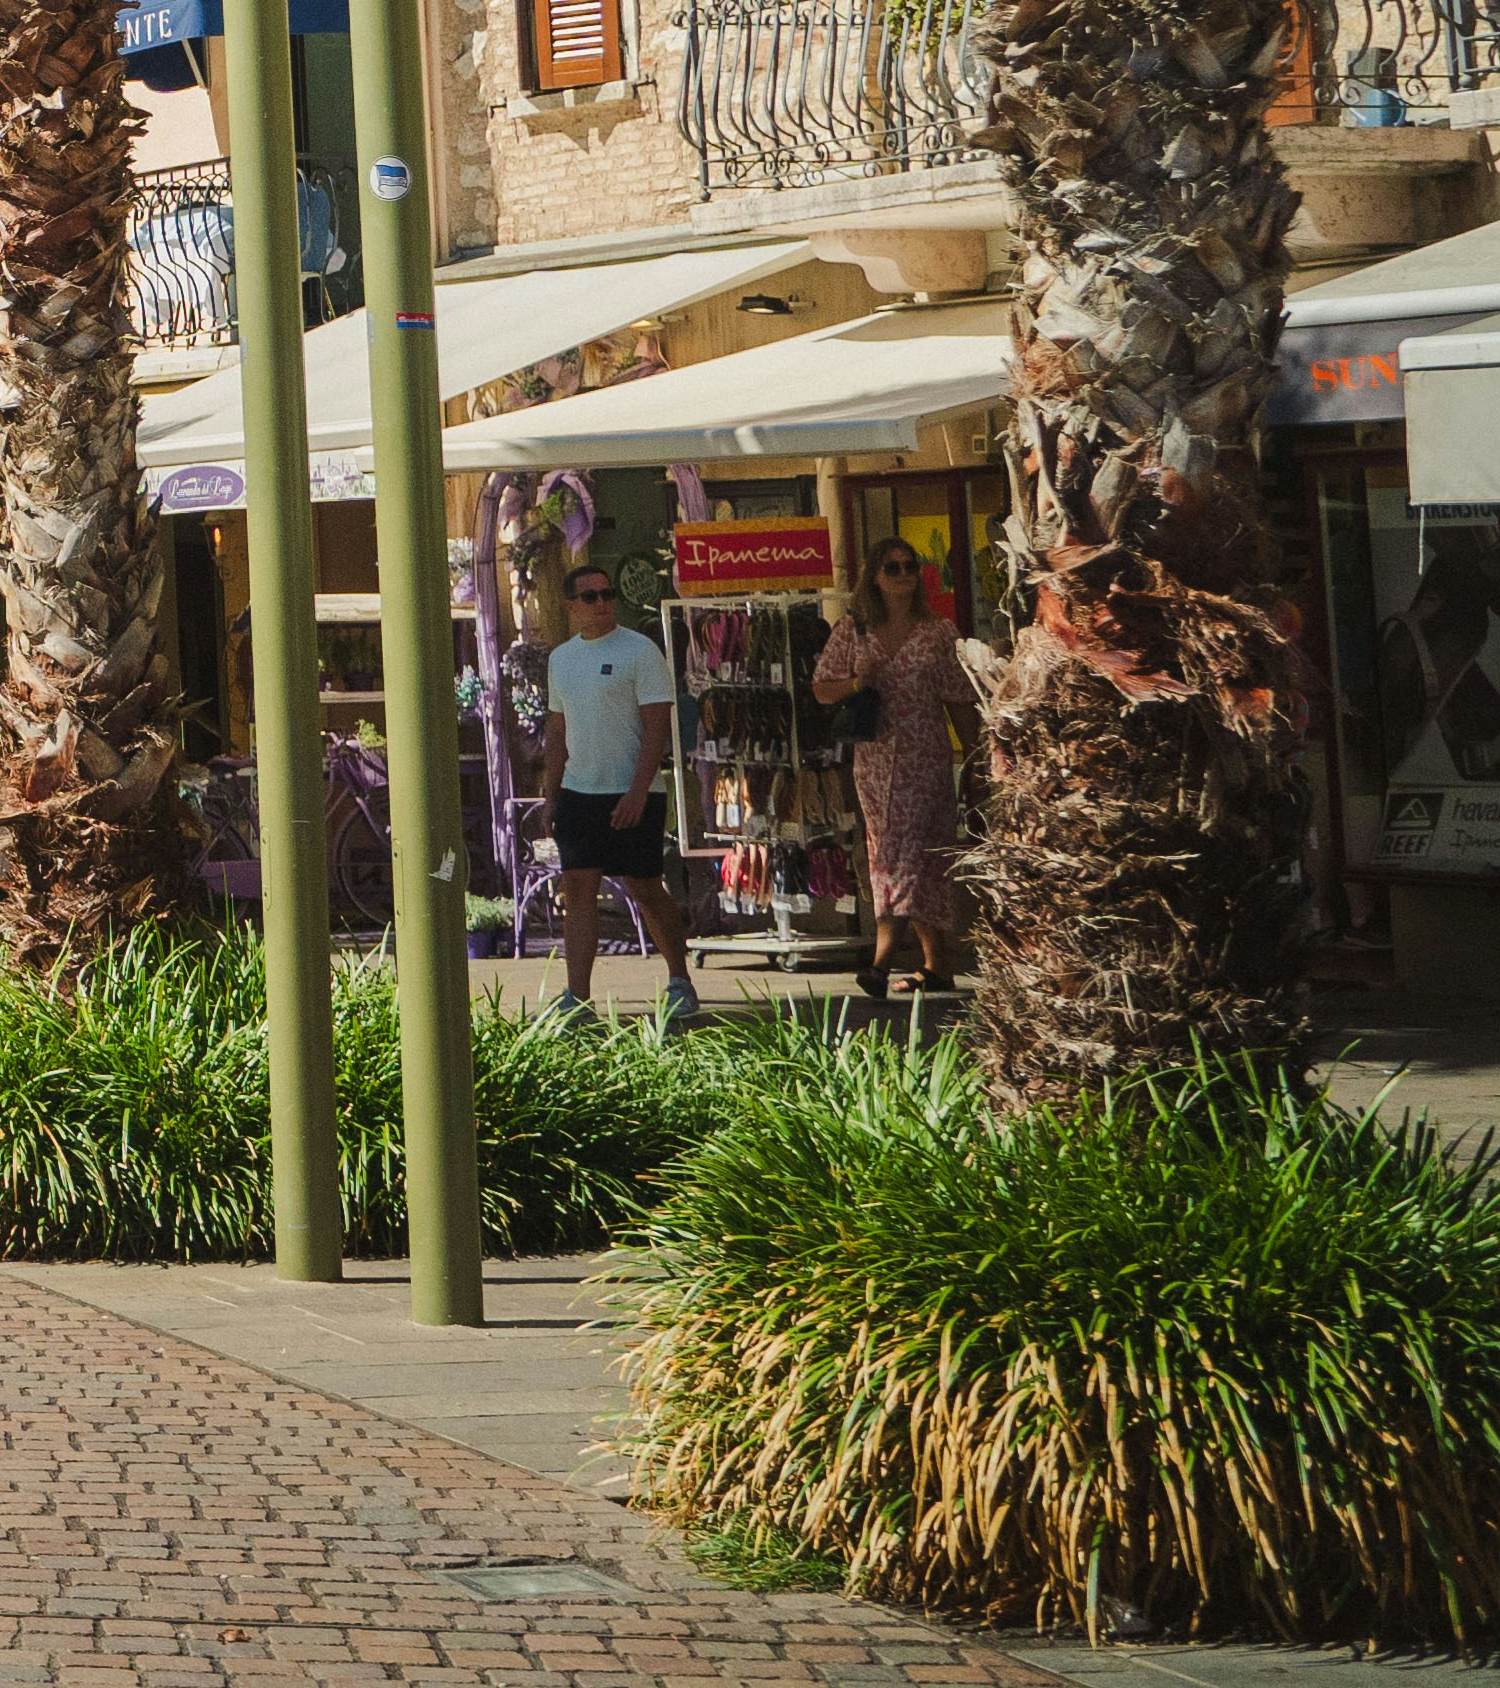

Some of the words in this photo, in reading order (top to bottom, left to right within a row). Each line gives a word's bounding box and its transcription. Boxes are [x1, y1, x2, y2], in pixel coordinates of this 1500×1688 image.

[114, 9, 173, 48] NTE
[1311, 352, 1399, 393] SUN
[684, 539, 825, 576] Ipanema
[1451, 797, 1500, 823] hava
[1380, 834, 1430, 855] REEF
